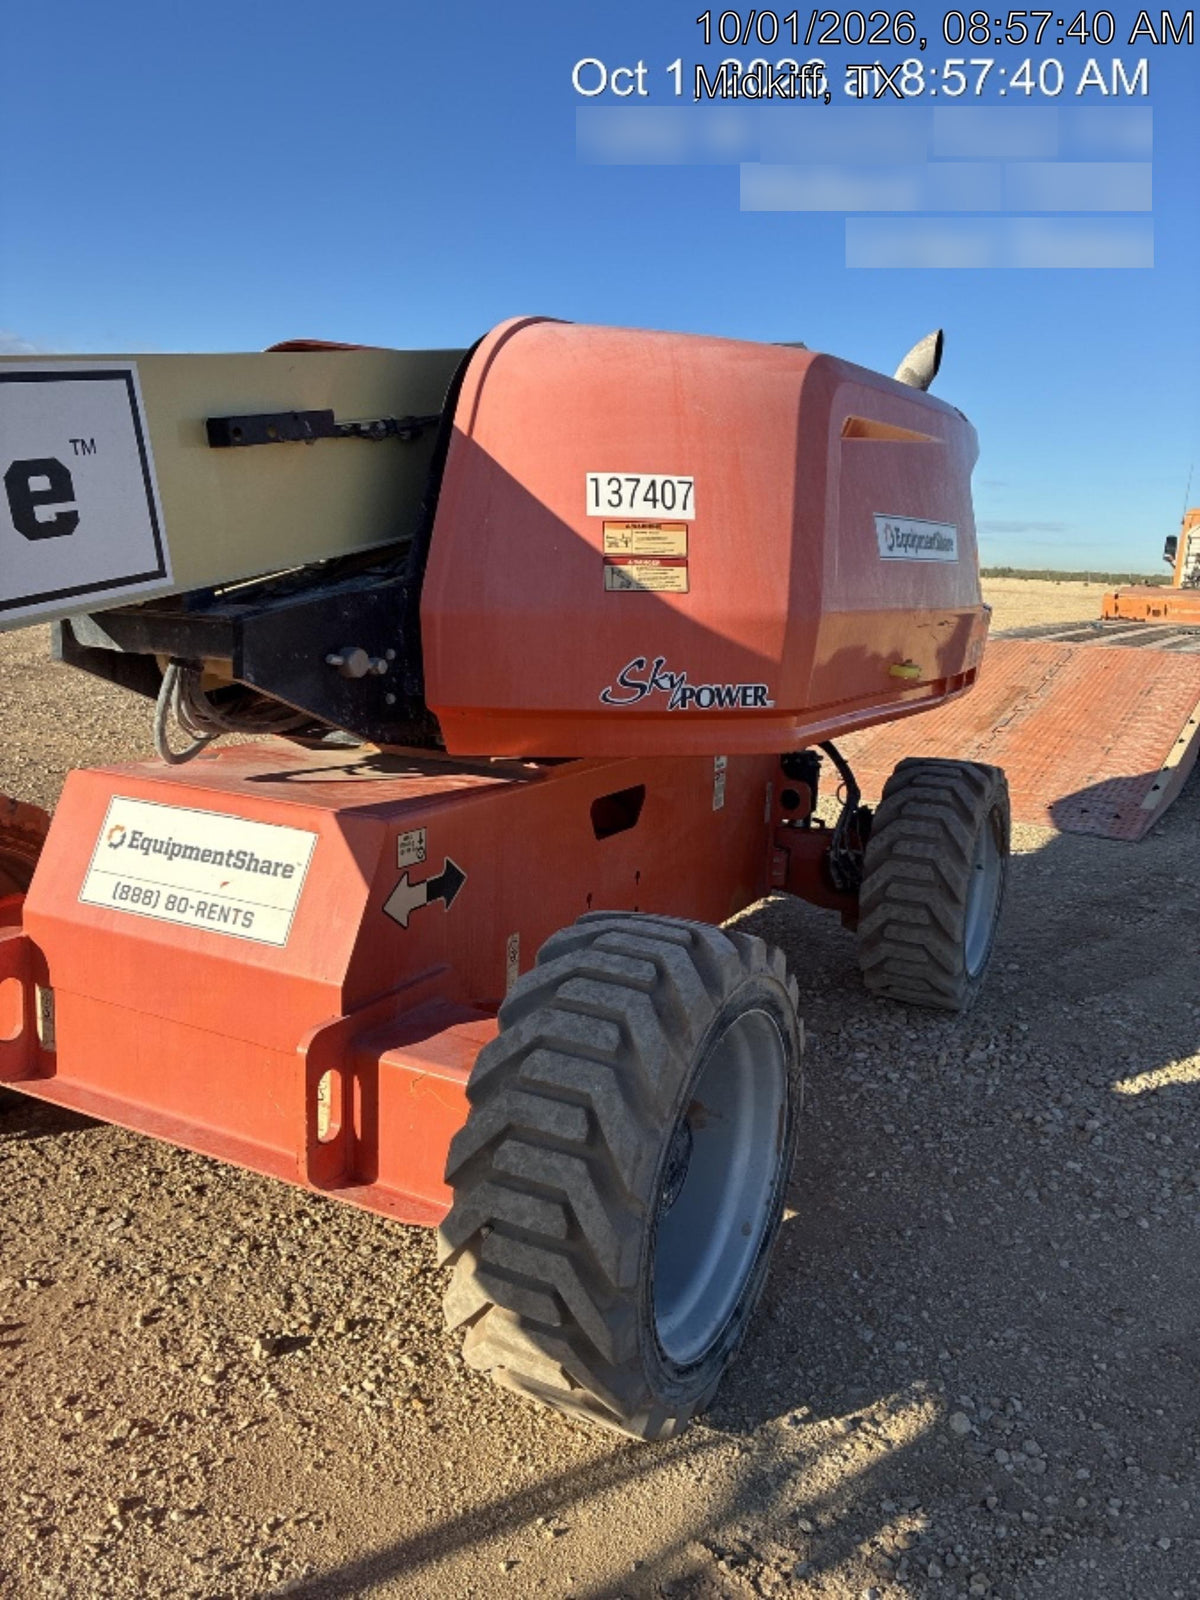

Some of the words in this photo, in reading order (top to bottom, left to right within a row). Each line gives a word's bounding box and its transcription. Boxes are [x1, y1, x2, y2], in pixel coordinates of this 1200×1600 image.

[3, 457, 80, 541] e
[590, 477, 693, 511] 137407
[679, 684, 768, 710] POWER
[128, 830, 295, 879] EquipmentShare
[112, 881, 161, 909] (888)
[164, 893, 255, 929] 80-RENTS
